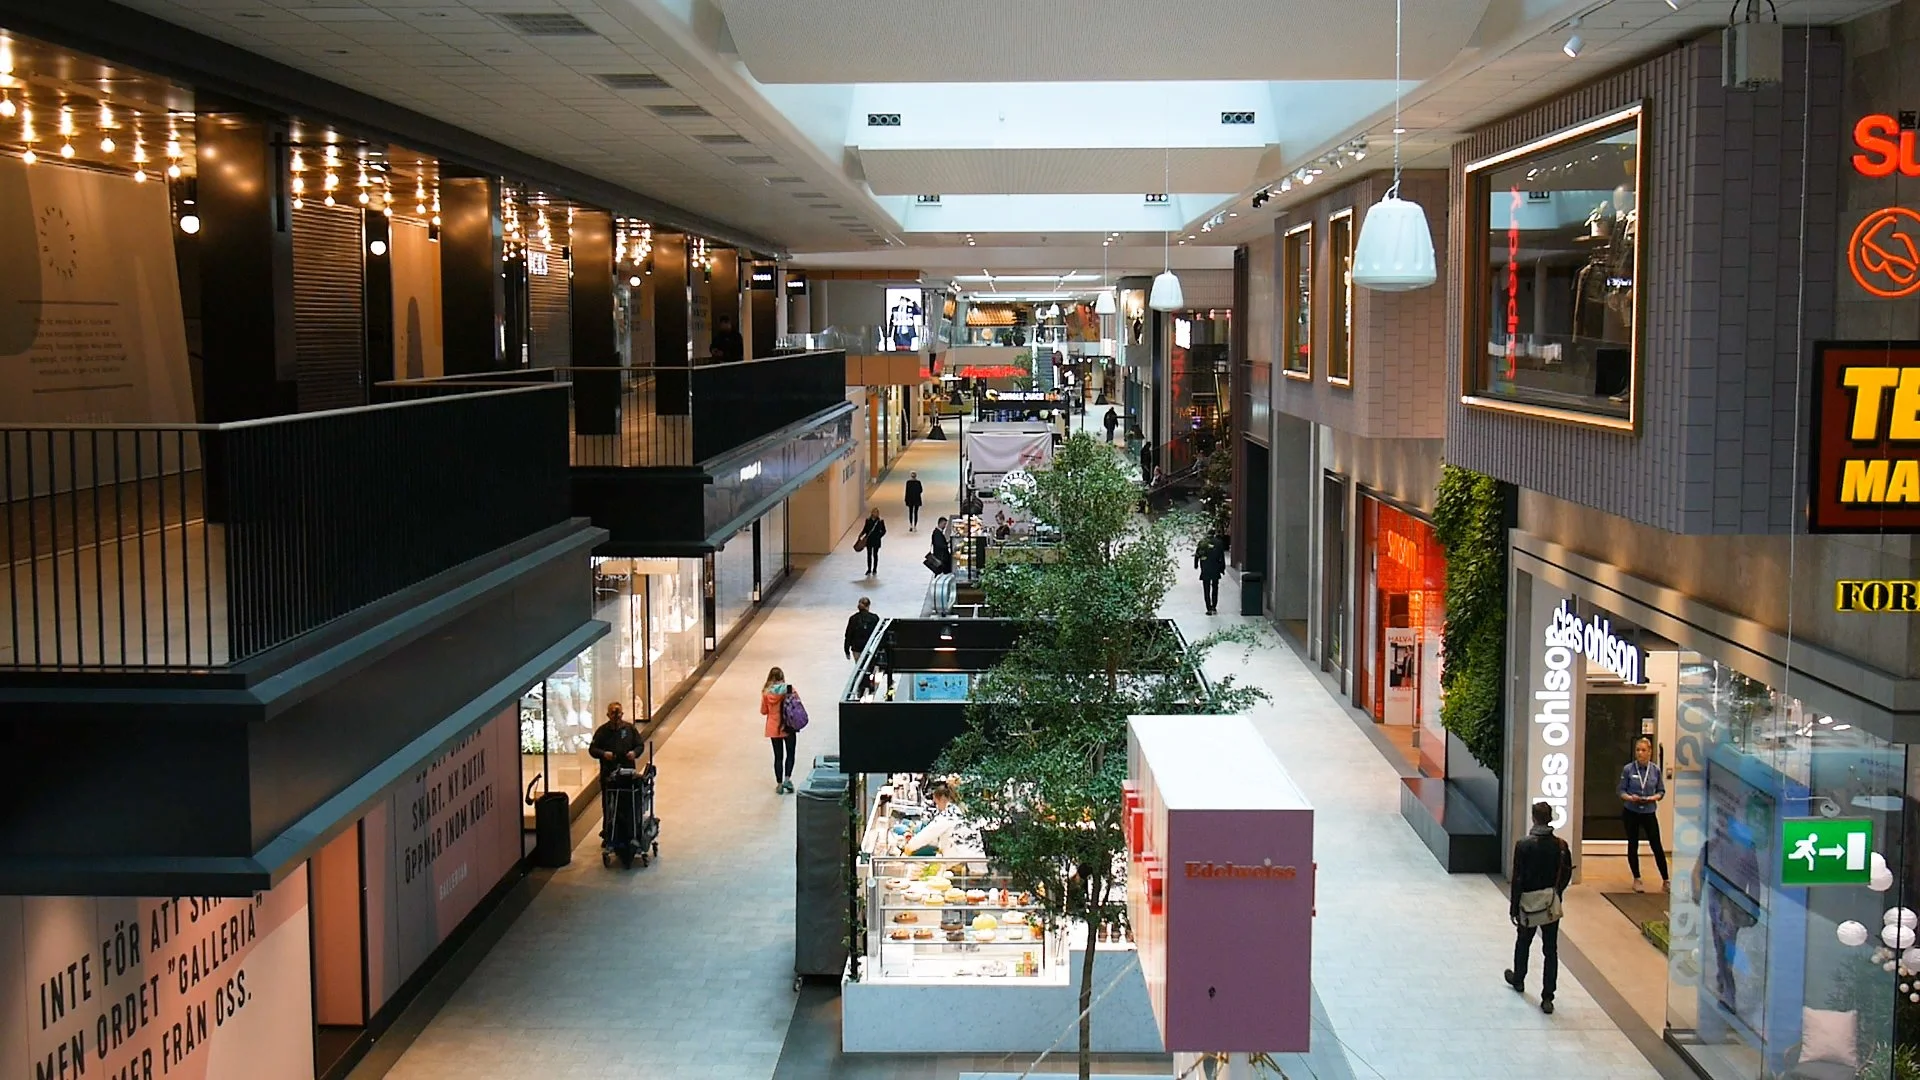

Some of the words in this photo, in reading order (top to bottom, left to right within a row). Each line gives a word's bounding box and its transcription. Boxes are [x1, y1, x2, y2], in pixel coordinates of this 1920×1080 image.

[1844, 367, 1920, 439] TE
[1841, 460, 1920, 502] MA
[1553, 598, 1583, 654] clas
[1584, 615, 1640, 685] ohlson
[404, 828, 442, 884] ÖPPNAR
[445, 804, 468, 848] INOM
[41, 953, 92, 1030] INTE
[103, 920, 140, 986] FÖR
[151, 896, 179, 953] ATT
[96, 975, 159, 1060] ORDET
[163, 1001, 207, 1074] FRÅN
[215, 969, 251, 1027] OSS.
